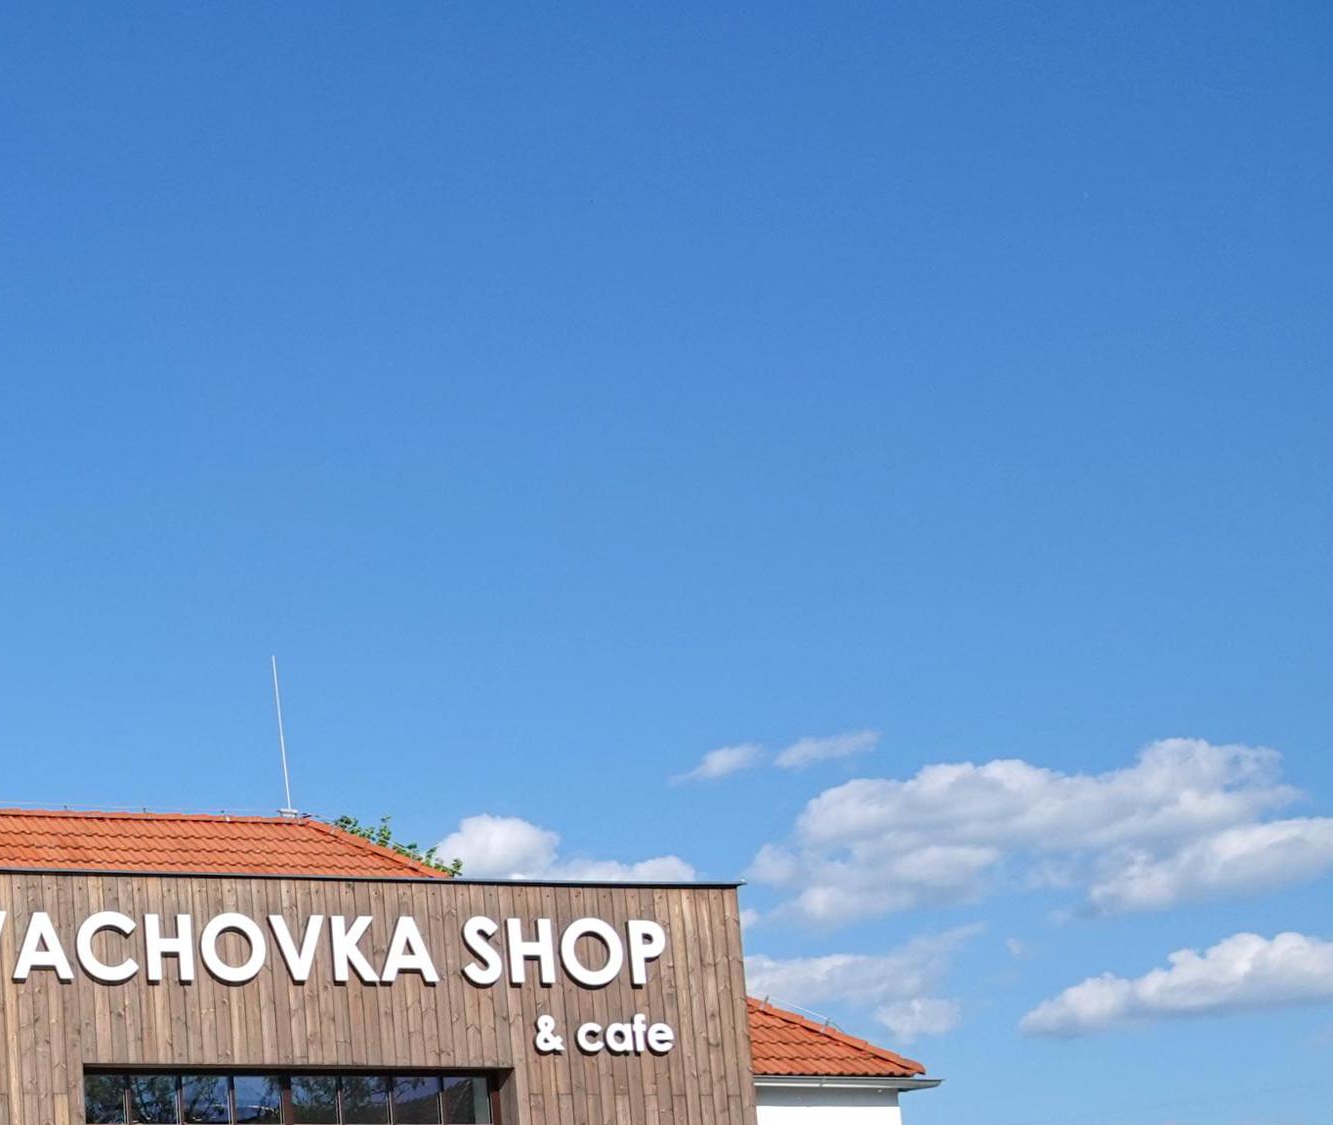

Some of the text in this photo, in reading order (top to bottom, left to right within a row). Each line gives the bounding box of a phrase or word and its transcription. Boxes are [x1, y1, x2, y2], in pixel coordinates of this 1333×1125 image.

[462, 915, 667, 986] SHOP
[536, 1013, 675, 1053] & cafe
